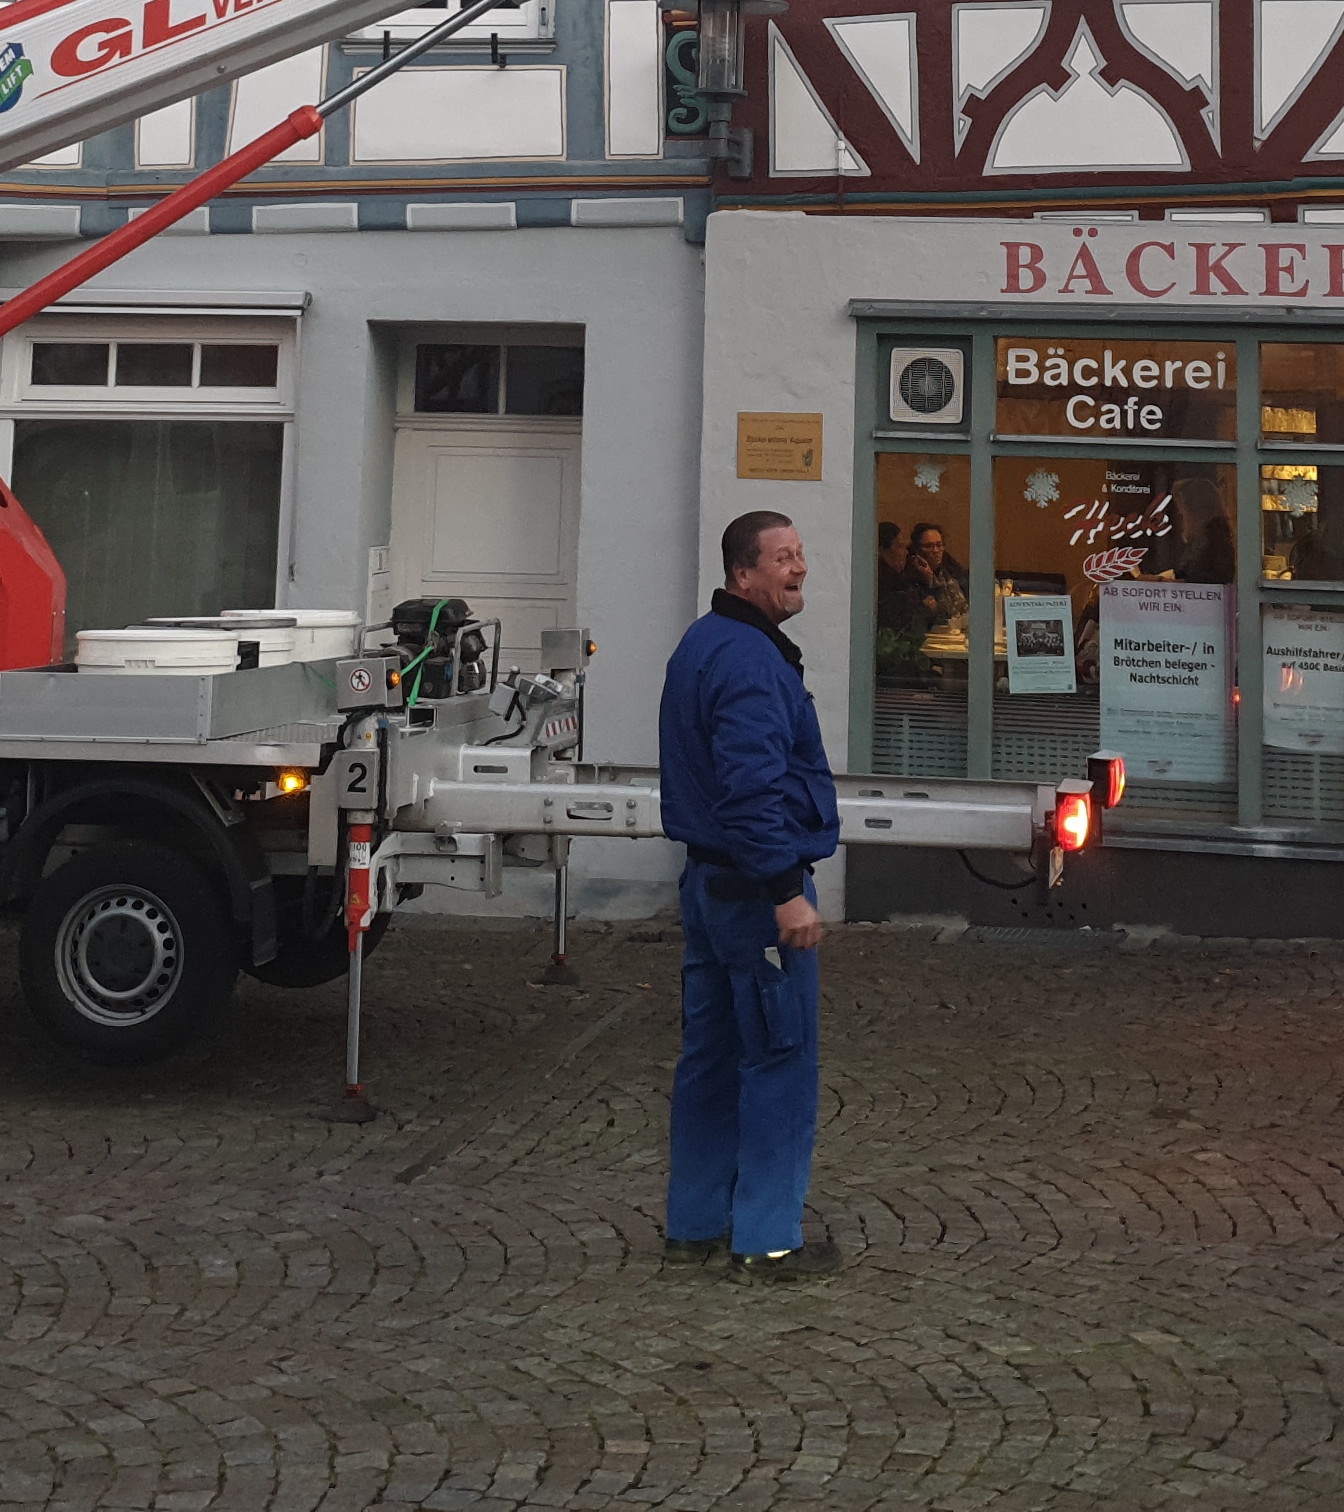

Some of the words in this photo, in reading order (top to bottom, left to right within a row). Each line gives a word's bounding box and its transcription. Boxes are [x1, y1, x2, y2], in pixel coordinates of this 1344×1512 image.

[1, 65, 23, 95] LIFT
[1006, 347, 1227, 390] Bäckerei
[1066, 395, 1163, 431] Cafe
[1105, 470, 1141, 481] Bäckerei
[1110, 483, 1151, 494] Konditorei
[1063, 491, 1173, 546] Heck
[1103, 587, 1119, 597] AB
[1121, 588, 1167, 599] SOFORT
[1171, 590, 1222, 601] STELLEN
[1139, 601, 1161, 612] WIR
[1202, 641, 1215, 655] in
[1113, 655, 1162, 669] Brötchen
[1164, 658, 1208, 673] belegen
[1129, 672, 1200, 686] Nachtschicht
[346, 762, 368, 793] 2
